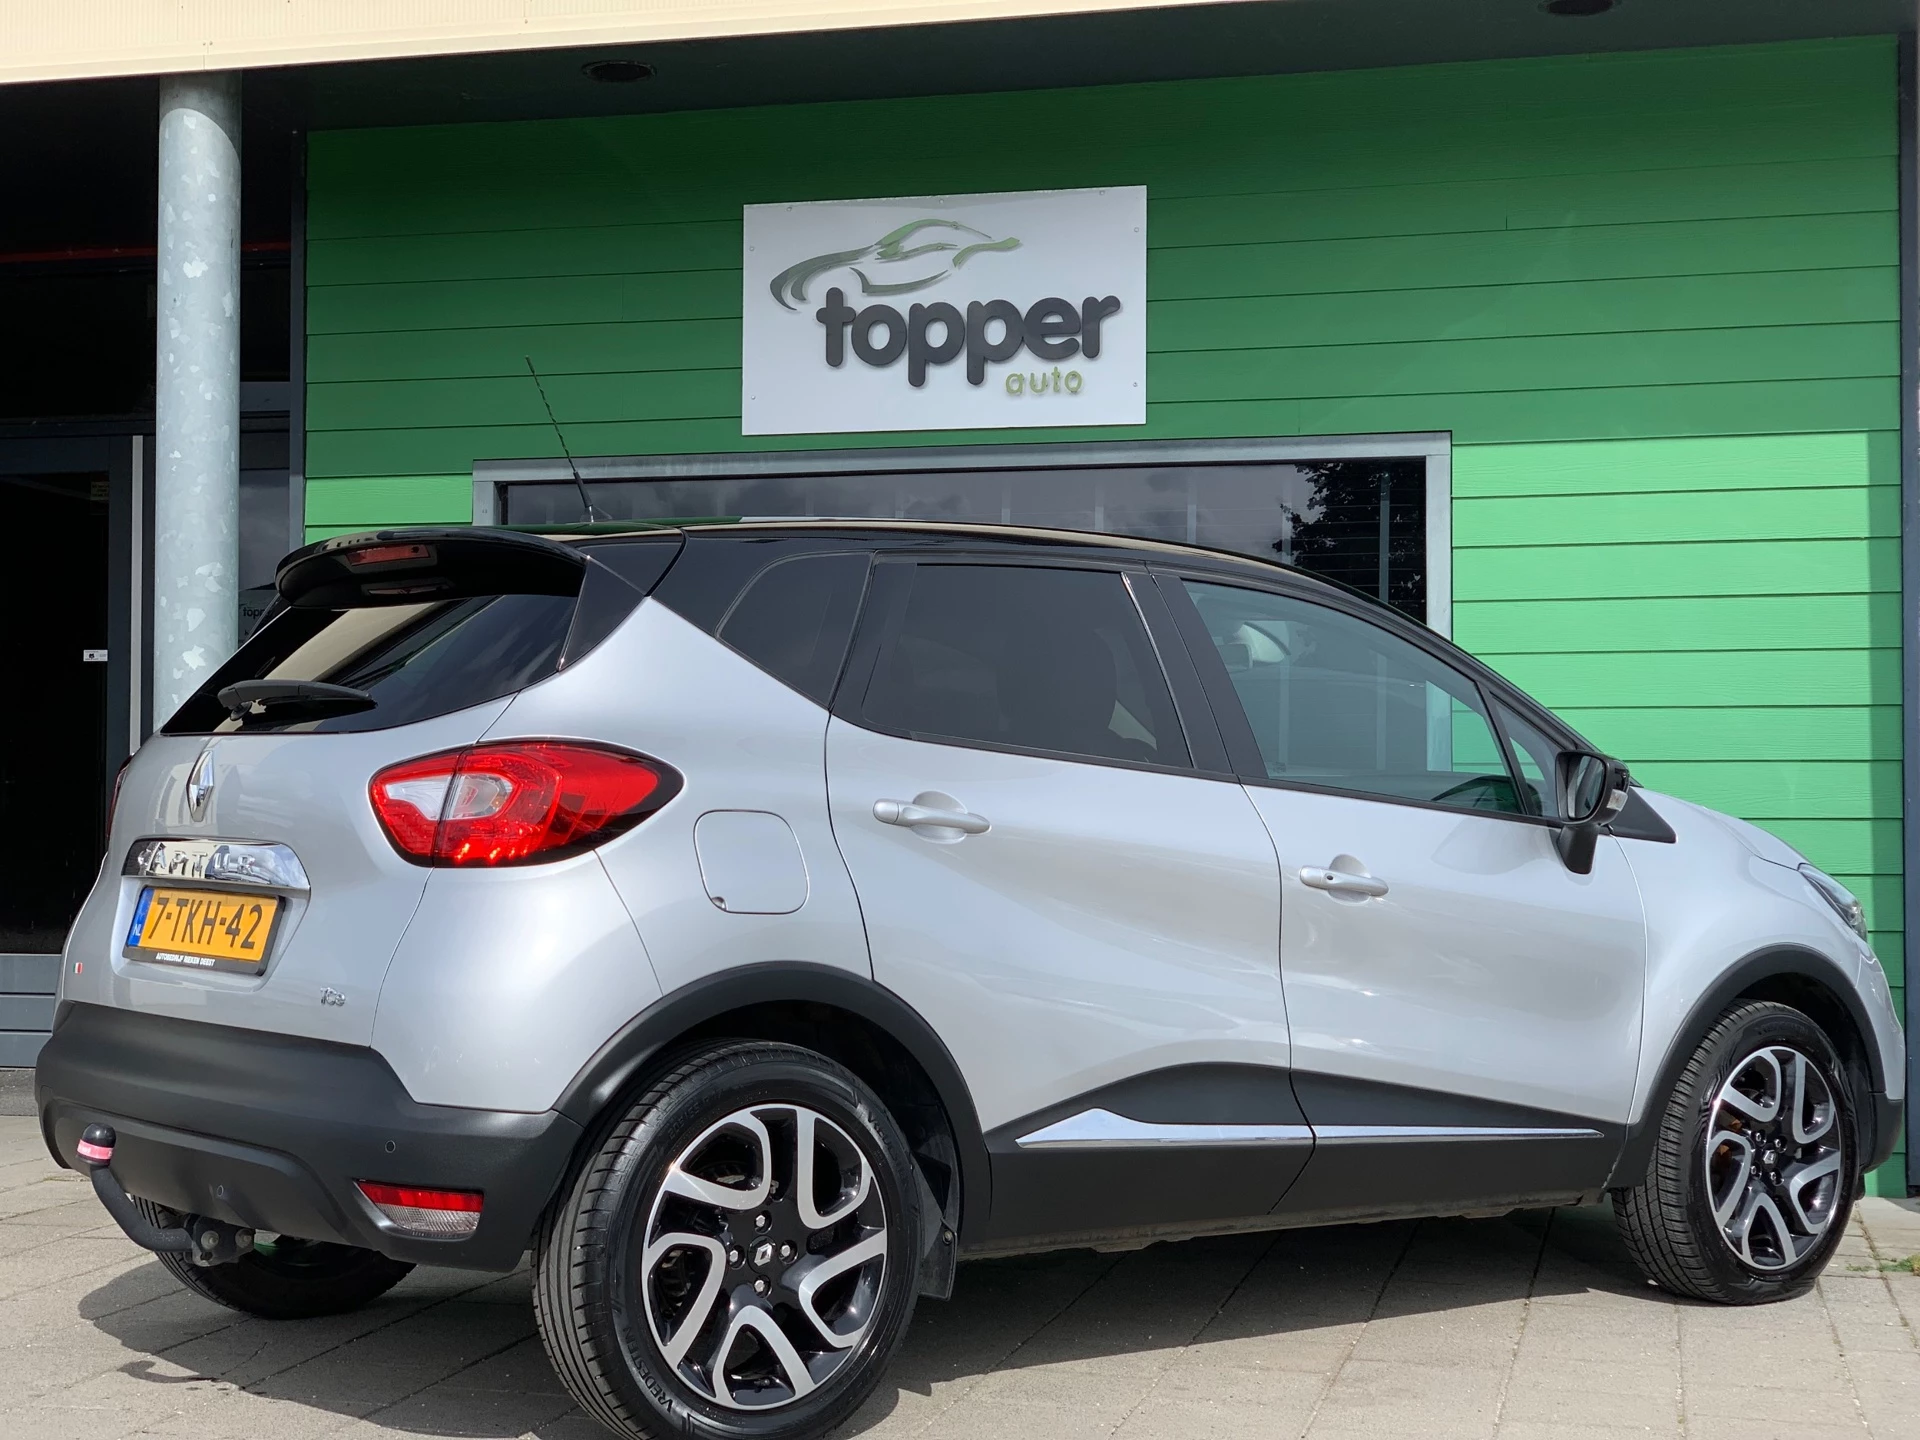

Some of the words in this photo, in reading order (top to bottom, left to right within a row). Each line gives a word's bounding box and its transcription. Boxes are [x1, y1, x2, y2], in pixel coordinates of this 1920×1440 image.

[816, 286, 1121, 387] topper
[1006, 366, 1083, 395] auto
[148, 897, 263, 950] 7-TKH-42
